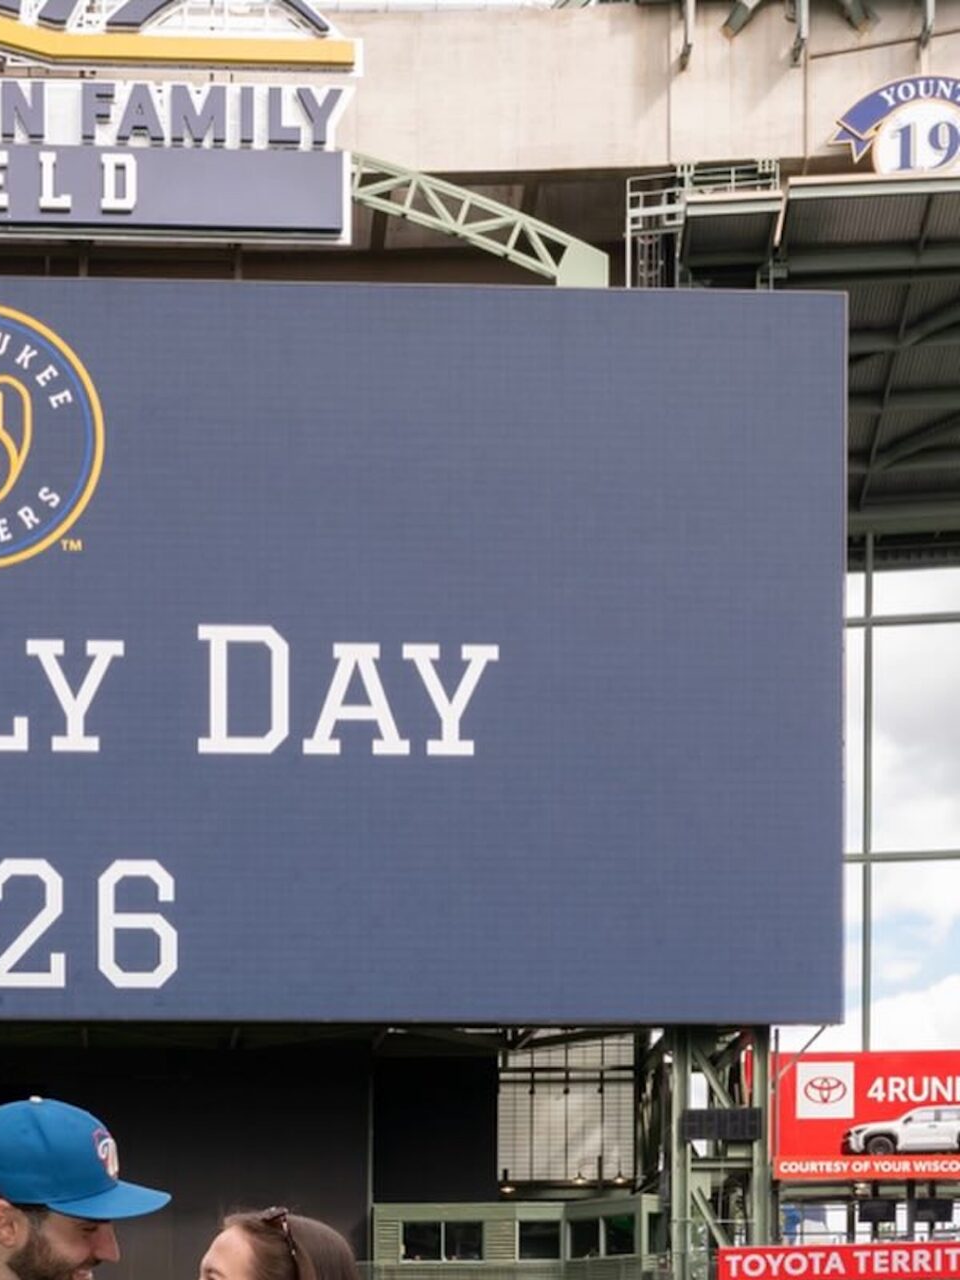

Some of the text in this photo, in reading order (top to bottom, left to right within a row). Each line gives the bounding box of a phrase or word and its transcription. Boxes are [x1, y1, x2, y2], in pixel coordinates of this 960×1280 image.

[879, 79, 960, 107] YOUN
[82, 83, 344, 145] FAMILY
[61, 539, 82, 551] TM
[197, 623, 500, 757] DAY
[866, 1076, 960, 1103] 4RUN
[779, 1160, 850, 1174] COURTESY
[852, 1160, 871, 1173] OF
[873, 1160, 912, 1173] YOUR
[724, 1251, 846, 1278] TOYOTA
